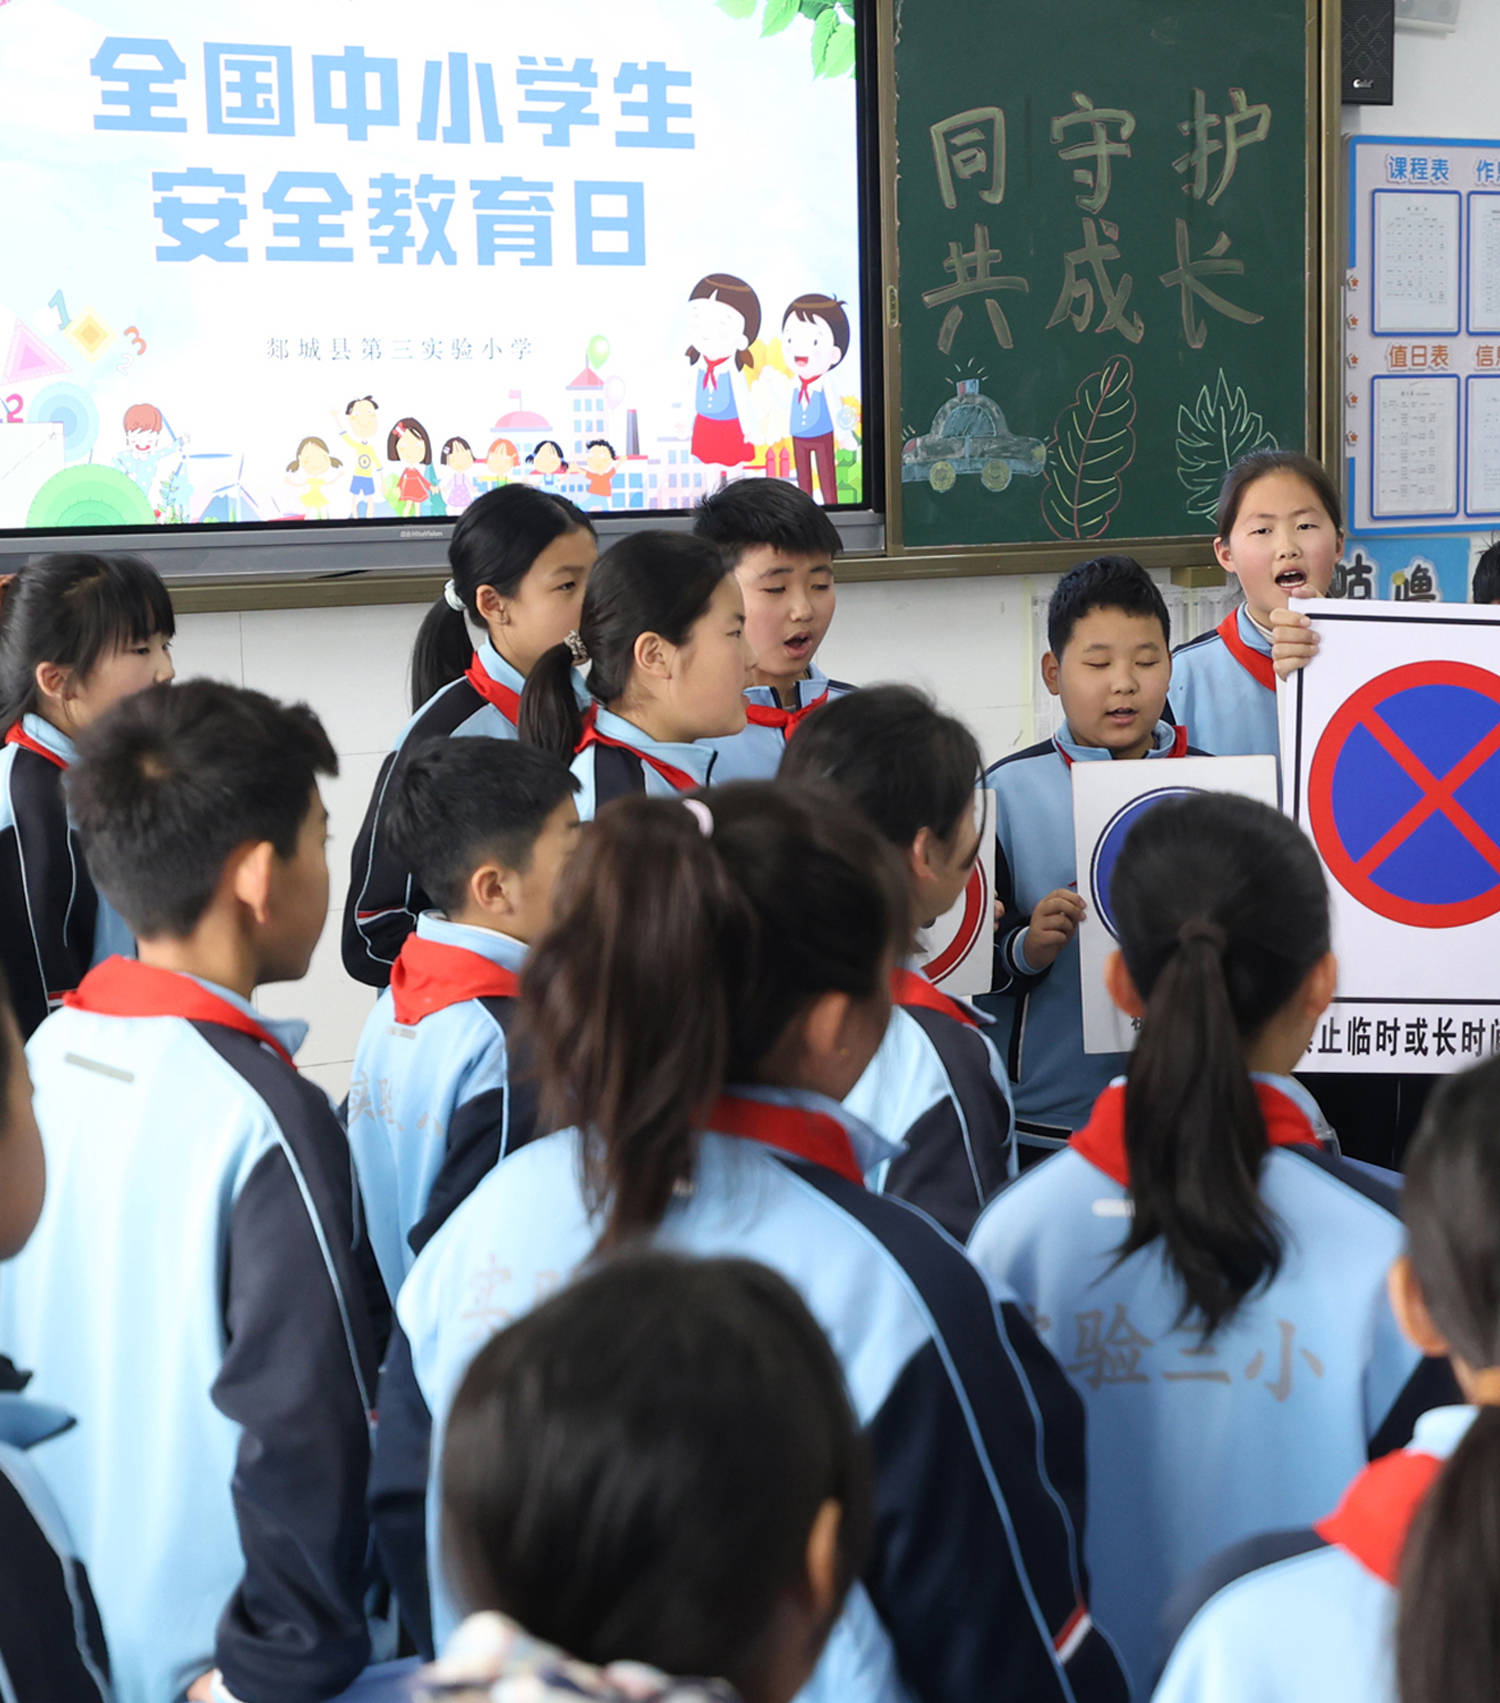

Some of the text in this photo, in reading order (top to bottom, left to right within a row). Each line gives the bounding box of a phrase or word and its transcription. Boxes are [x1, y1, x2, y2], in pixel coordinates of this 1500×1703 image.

[90, 36, 696, 150] 全国中小学生
[930, 87, 1272, 213] 同守护
[1389, 156, 1449, 181] 课程表
[152, 166, 647, 267] 安全教育日
[922, 217, 1264, 354] 共成长
[266, 337, 532, 361] 郯城县第三实验小学
[1389, 345, 1448, 368] 值日表
[1031, 1303, 1324, 1403] 验三小
